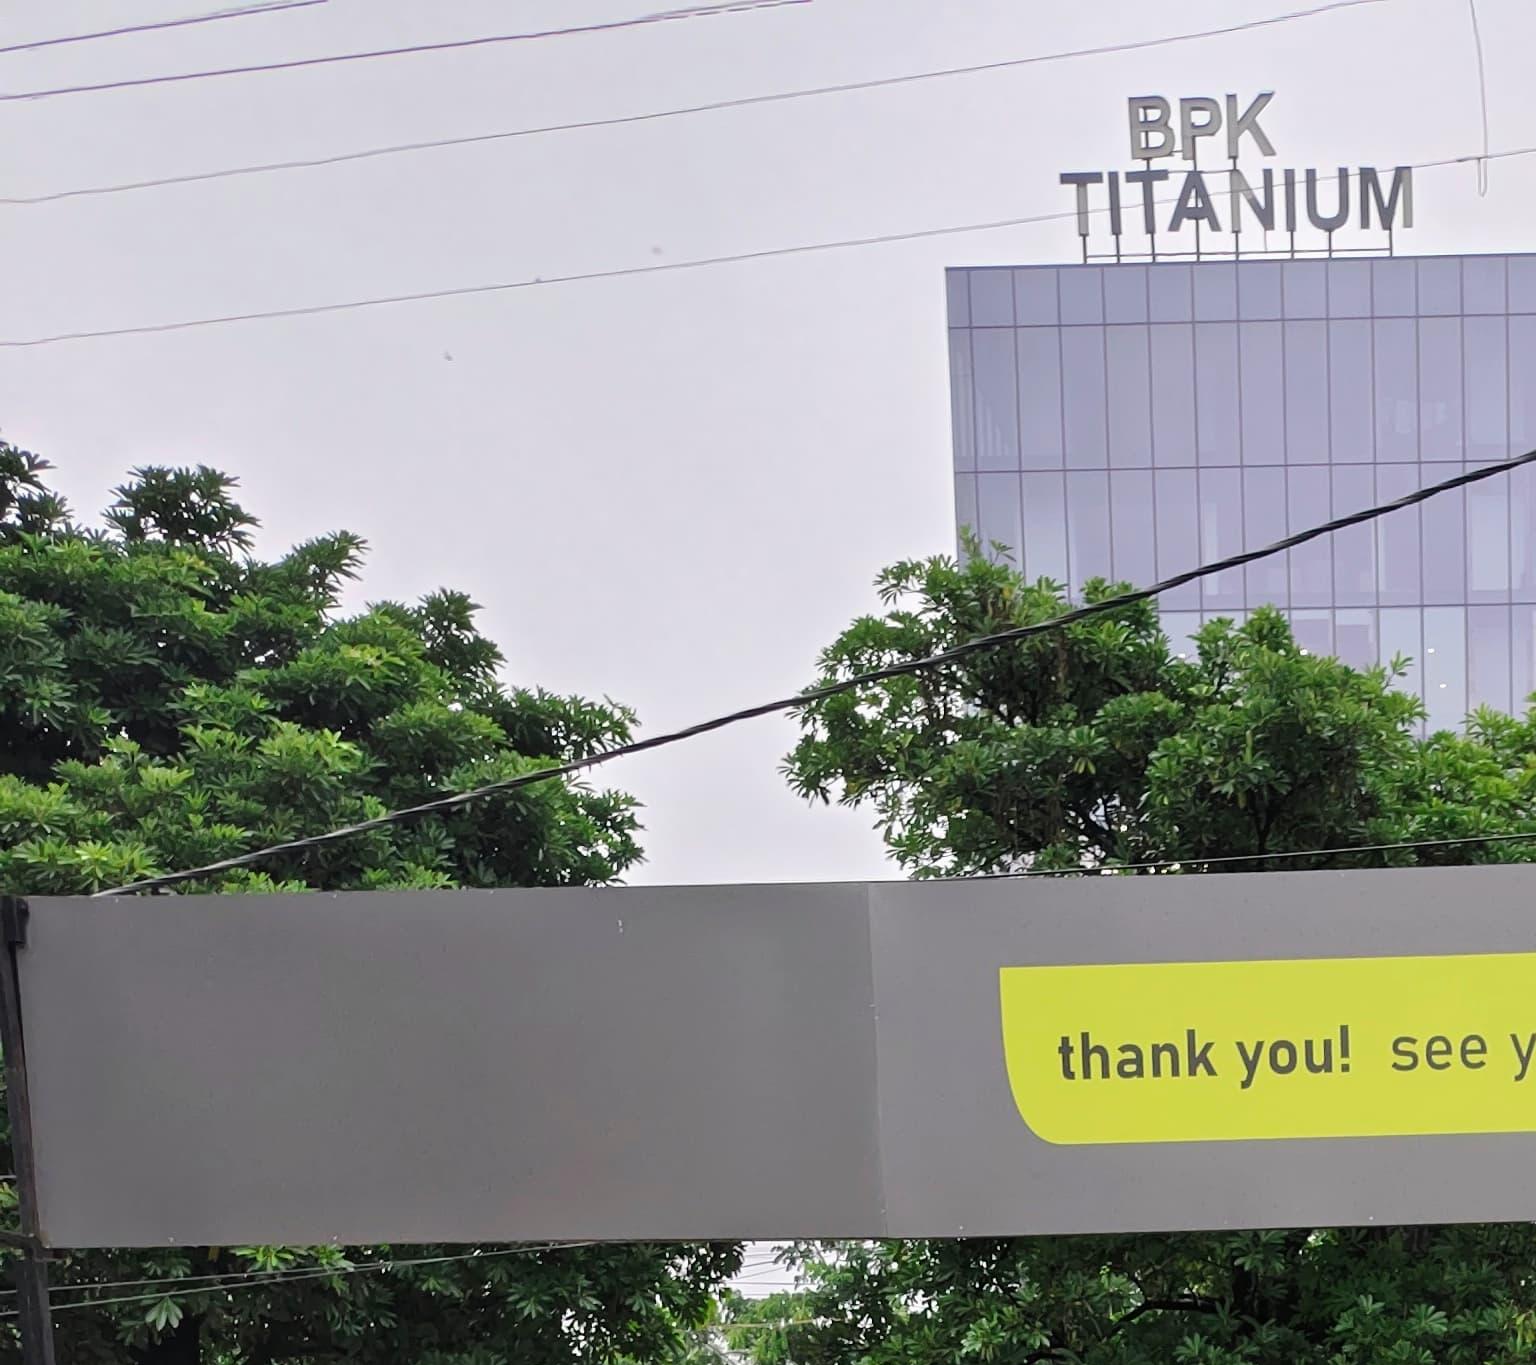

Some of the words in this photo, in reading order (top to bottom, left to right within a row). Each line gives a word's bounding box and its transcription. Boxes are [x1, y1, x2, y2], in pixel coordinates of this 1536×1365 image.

[1128, 91, 1277, 160] BPK
[1059, 166, 1413, 236] TITANIUM
[1058, 1029, 1218, 1080] thank
[1235, 1024, 1350, 1090] you!
[1391, 1032, 1488, 1071] see
